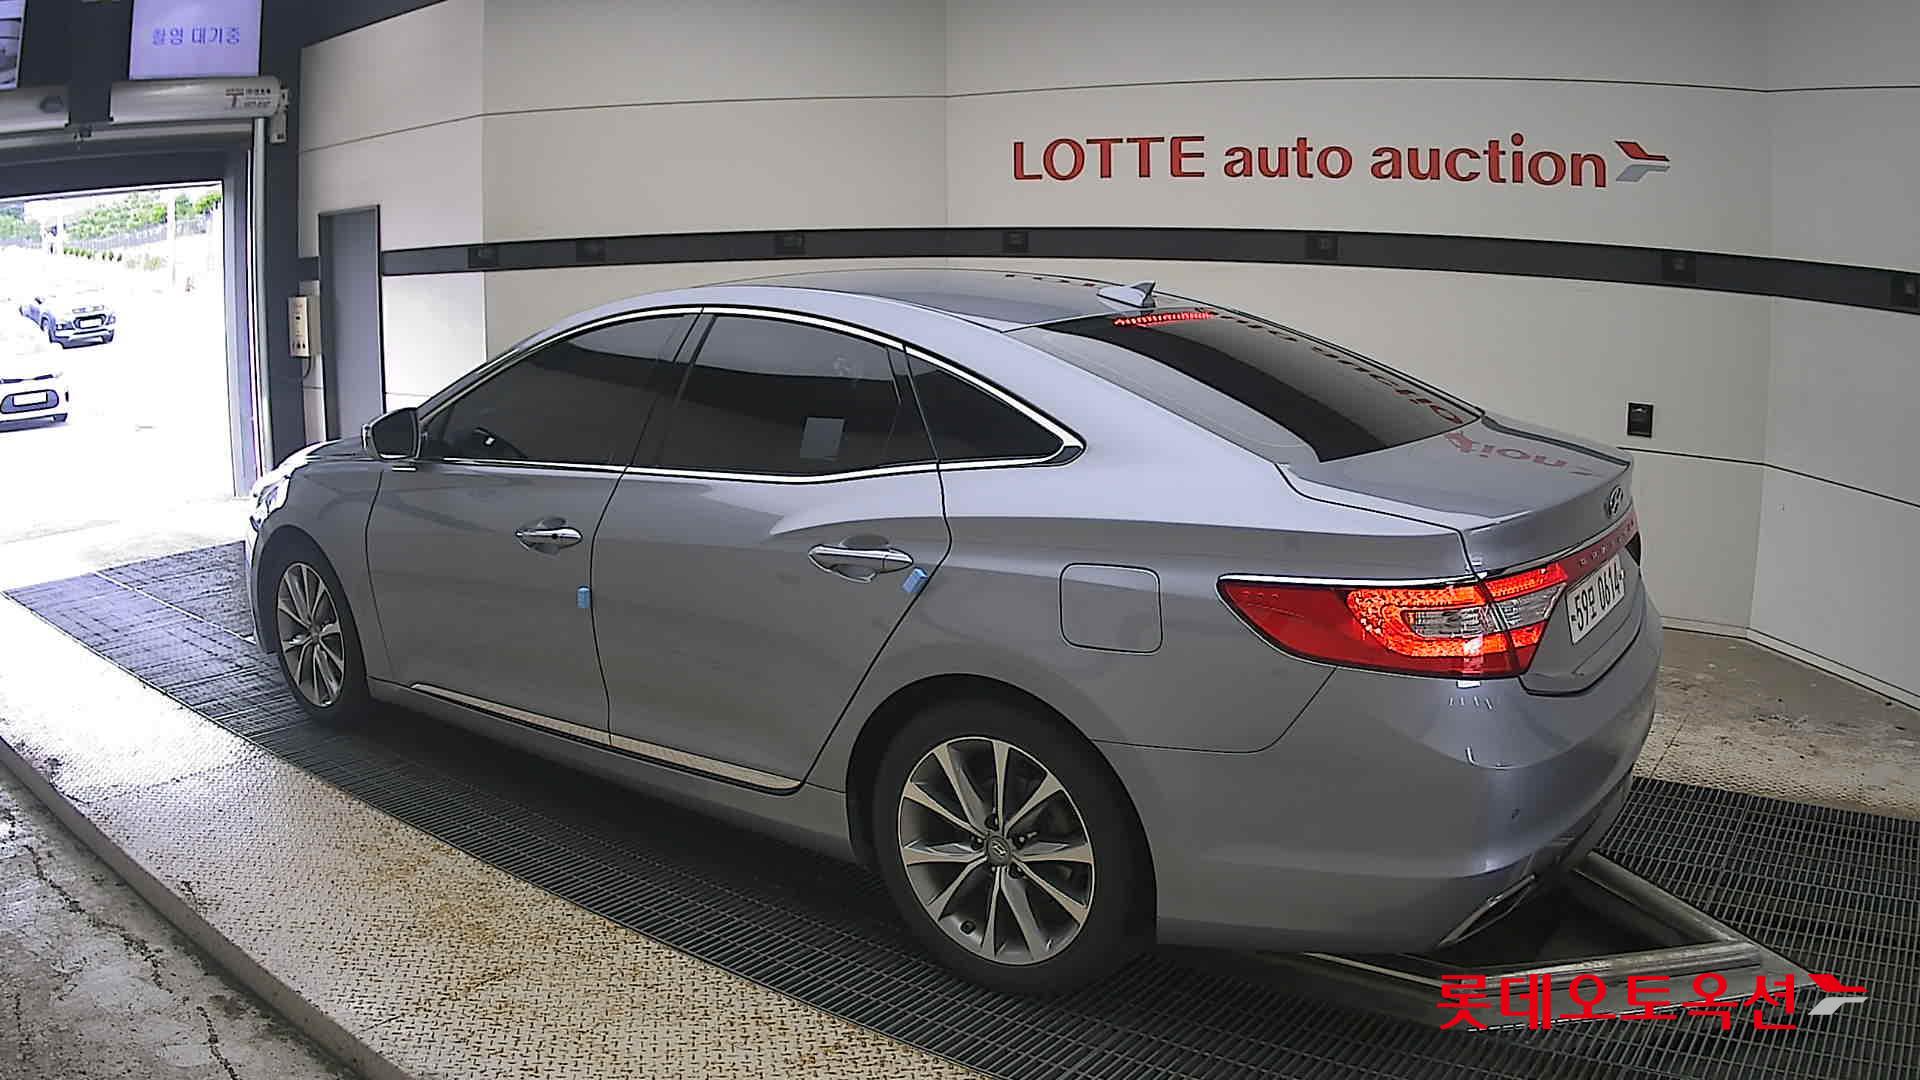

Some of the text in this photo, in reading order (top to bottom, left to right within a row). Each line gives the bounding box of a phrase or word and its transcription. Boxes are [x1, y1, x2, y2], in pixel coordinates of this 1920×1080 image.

[191, 26, 241, 45] 대기중
[1013, 132, 1607, 188] LOTTE auto auction
[1598, 562, 1621, 610] 0614
